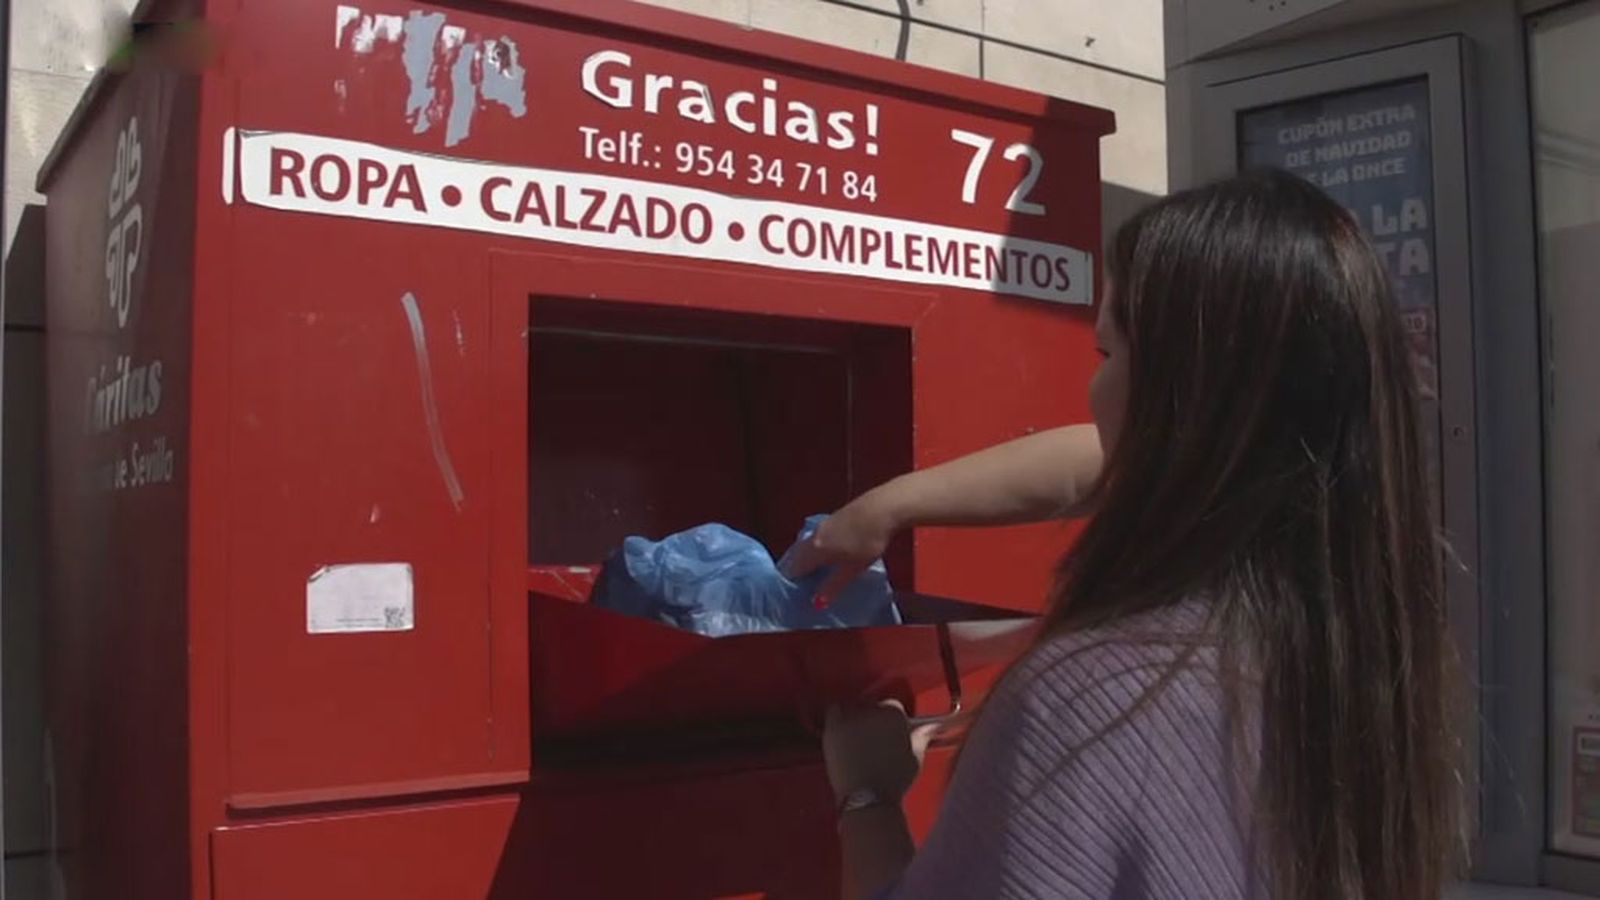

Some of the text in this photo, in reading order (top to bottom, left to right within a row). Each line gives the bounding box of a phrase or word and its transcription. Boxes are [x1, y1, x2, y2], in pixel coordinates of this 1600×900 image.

[581, 50, 879, 156] Gracias!
[1277, 103, 1416, 145] CUPÓN EXTRA
[578, 126, 878, 203] Telf.: 954 34 71 84
[1284, 130, 1413, 168] DE NAVIDAD
[951, 128, 1047, 216] 72
[1321, 168, 1349, 187] LA
[1352, 157, 1406, 182] ONCE
[269, 147, 1071, 292] ROPA CALZADO COMPLEMENTOS
[1372, 198, 1428, 236] LA
[1373, 238, 1430, 277] TA
